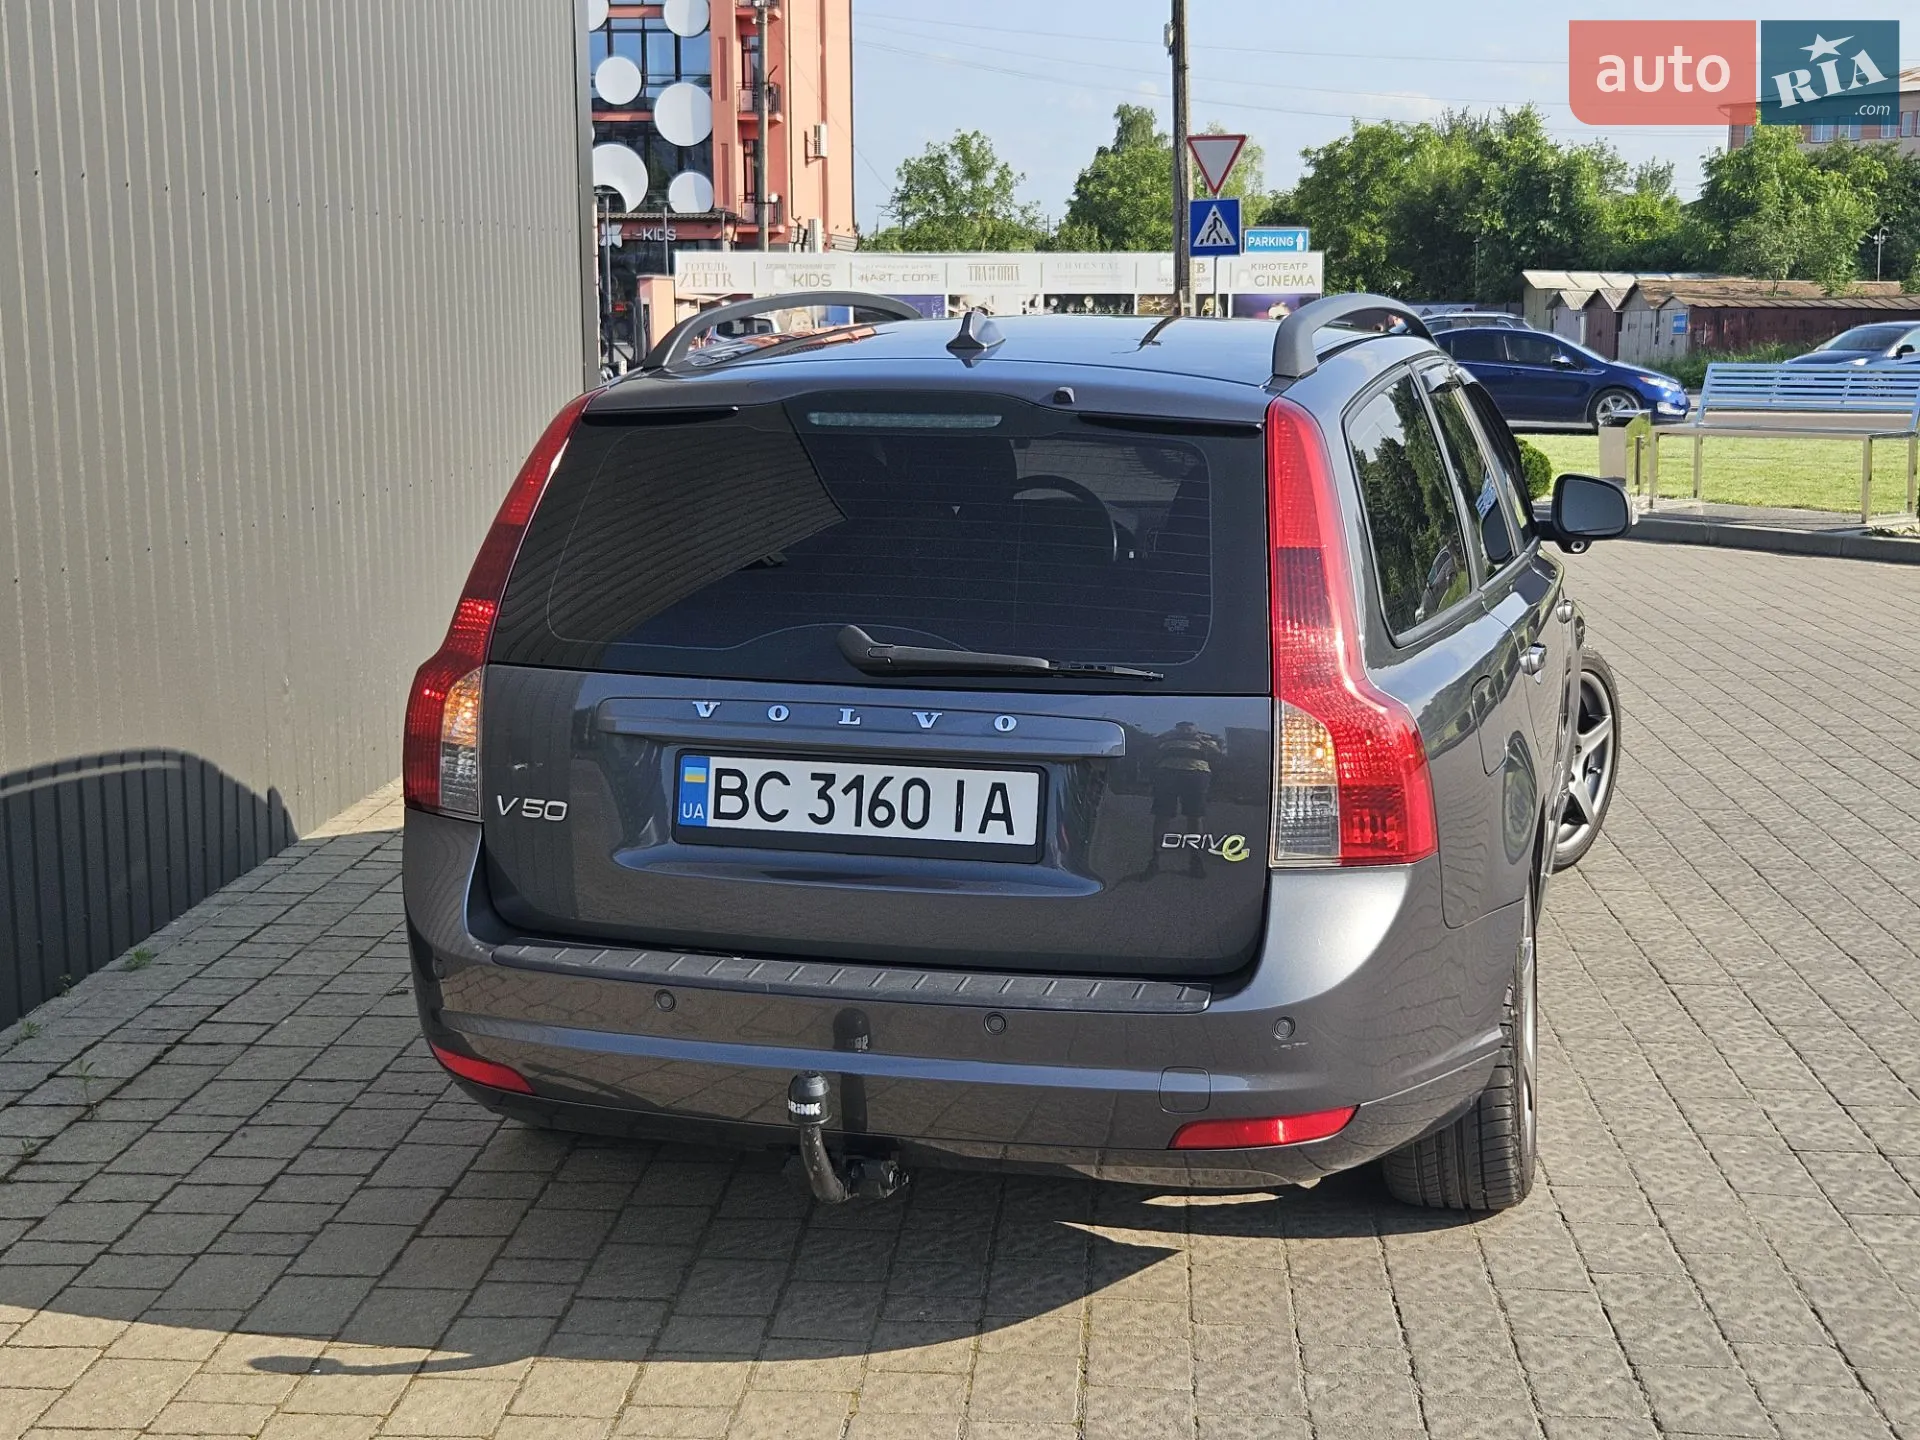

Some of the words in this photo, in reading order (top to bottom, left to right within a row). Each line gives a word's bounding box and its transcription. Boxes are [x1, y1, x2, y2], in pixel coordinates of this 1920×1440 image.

[1248, 236, 1294, 247] PARKING
[678, 272, 735, 288] ZEFIR
[792, 273, 833, 288] KIDS
[1254, 274, 1316, 287] CINEMA
[692, 700, 1018, 732] VOLVO
[497, 794, 569, 822] V50
[713, 767, 791, 823] BC
[808, 772, 931, 830] 3160
[954, 779, 1015, 836] IA
[682, 802, 705, 820] UA
